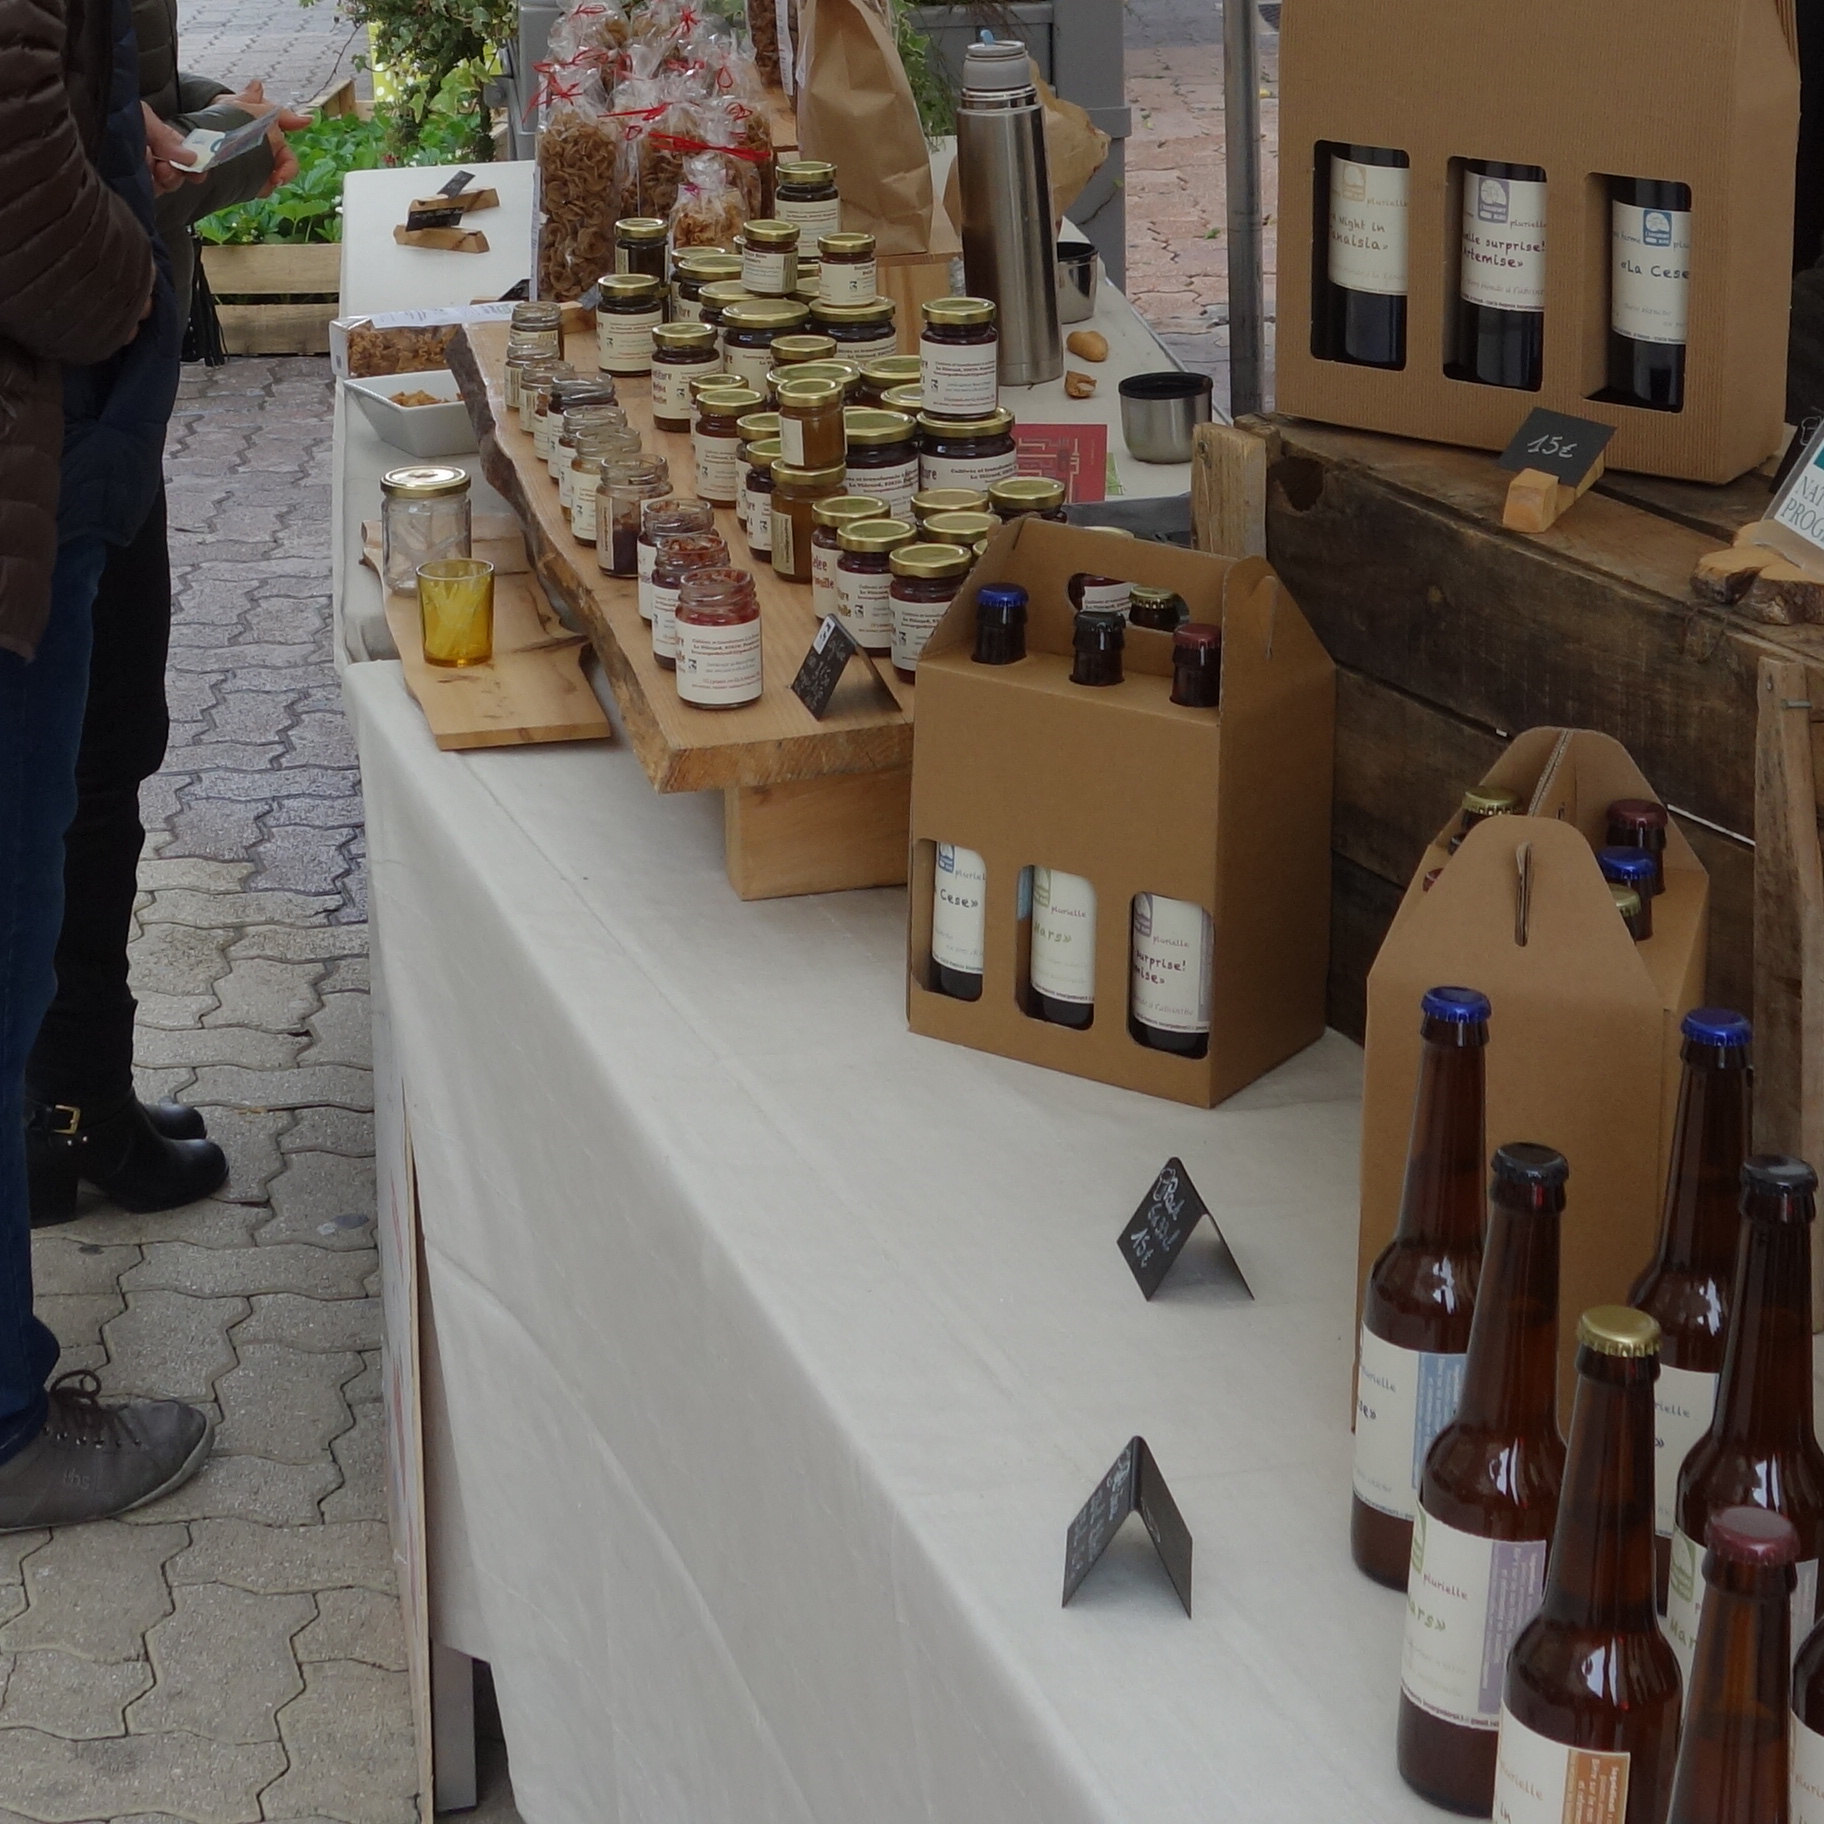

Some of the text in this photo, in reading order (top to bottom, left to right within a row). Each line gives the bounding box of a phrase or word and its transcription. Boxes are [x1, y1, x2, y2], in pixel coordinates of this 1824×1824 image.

[1340, 218, 1386, 233] Night in
[1486, 240, 1546, 256] surprise!
[1527, 434, 1578, 458] 15€
[955, 869, 986, 882] pluriel
[1051, 906, 1086, 919] plurielle
[1153, 934, 1190, 948] plurielle
[1423, 1573, 1468, 1600] plurielle
